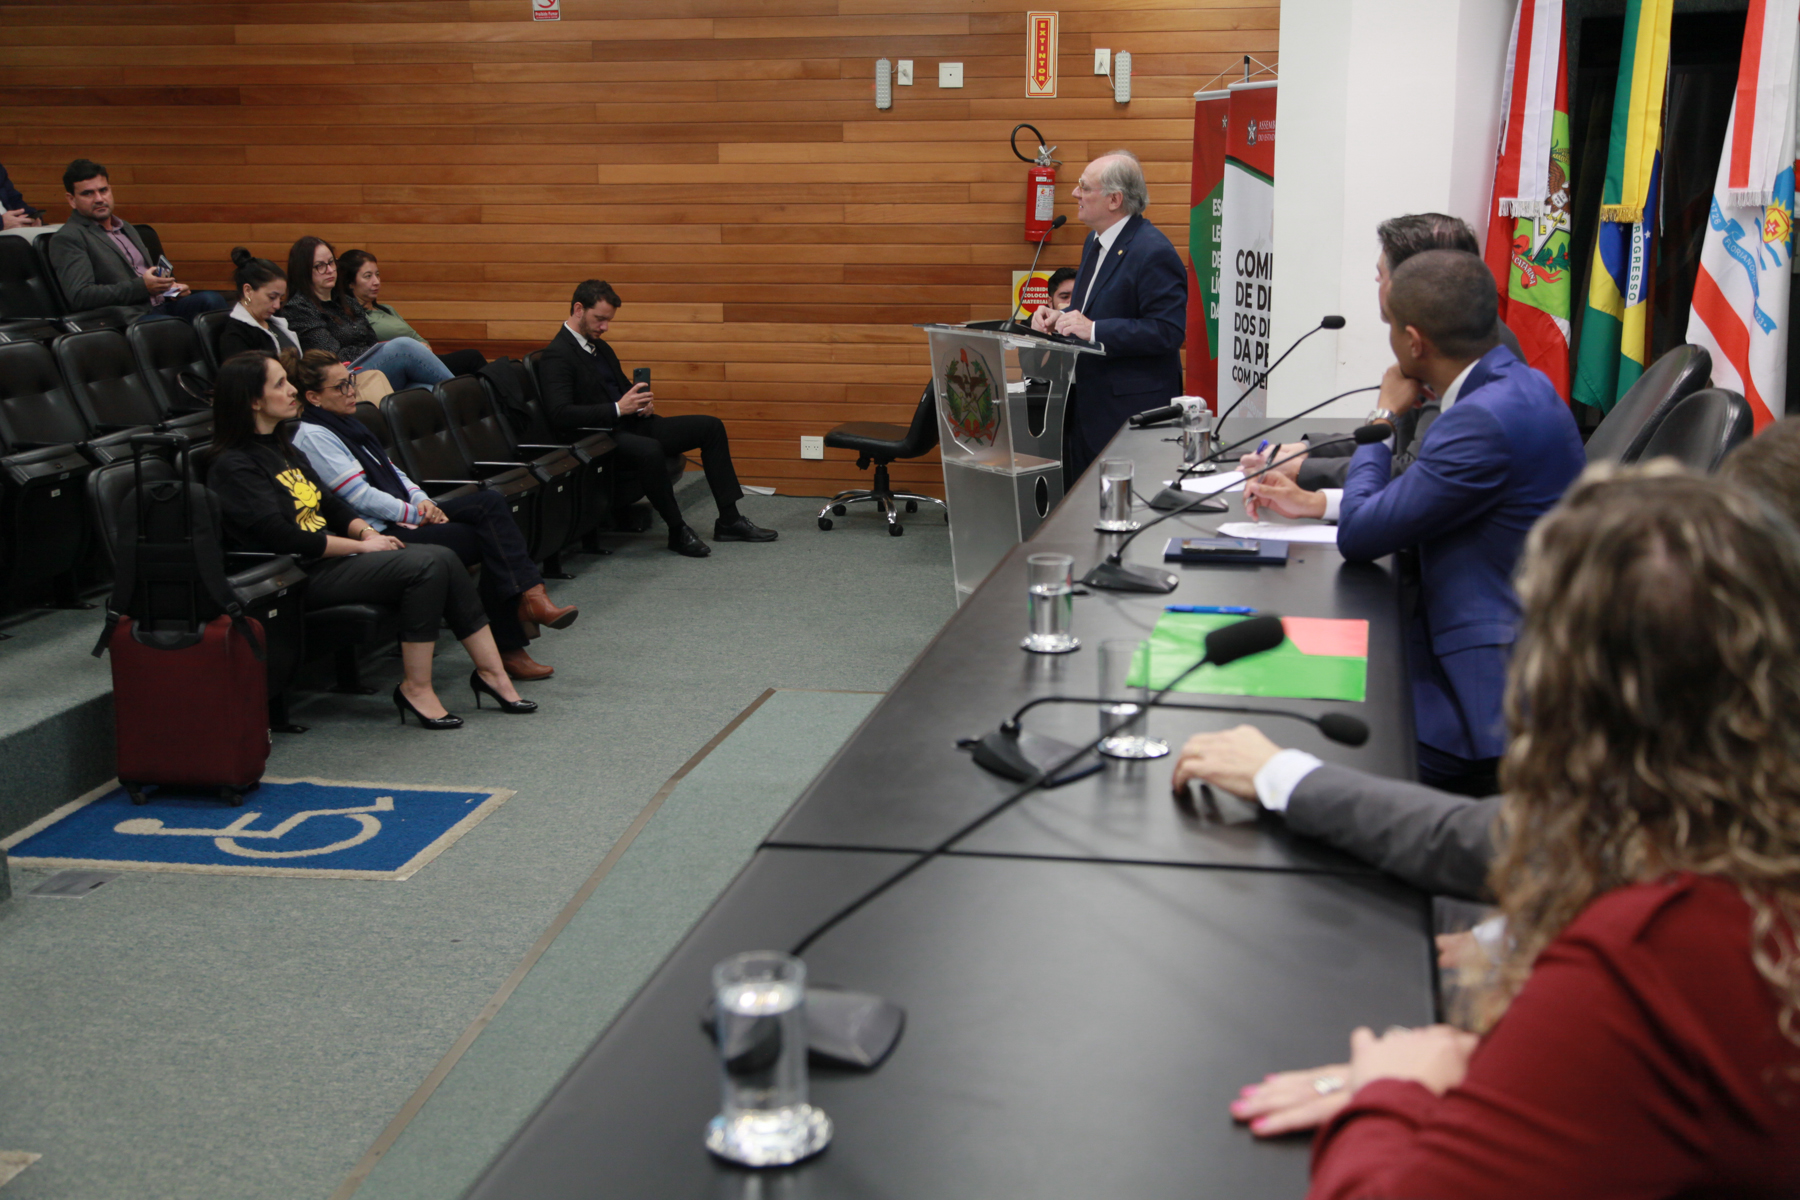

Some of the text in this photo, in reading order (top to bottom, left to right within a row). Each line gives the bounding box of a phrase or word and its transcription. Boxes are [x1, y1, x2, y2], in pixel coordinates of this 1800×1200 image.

[1038, 22, 1046, 81] EXTINTOR
[1711, 203, 1721, 225] 1726
[1514, 257, 1536, 285] CATARINA
[1235, 281, 1253, 309] DE
[1234, 312, 1256, 336] DOS
[1233, 335, 1251, 363] DA
[1232, 365, 1251, 385] COM
